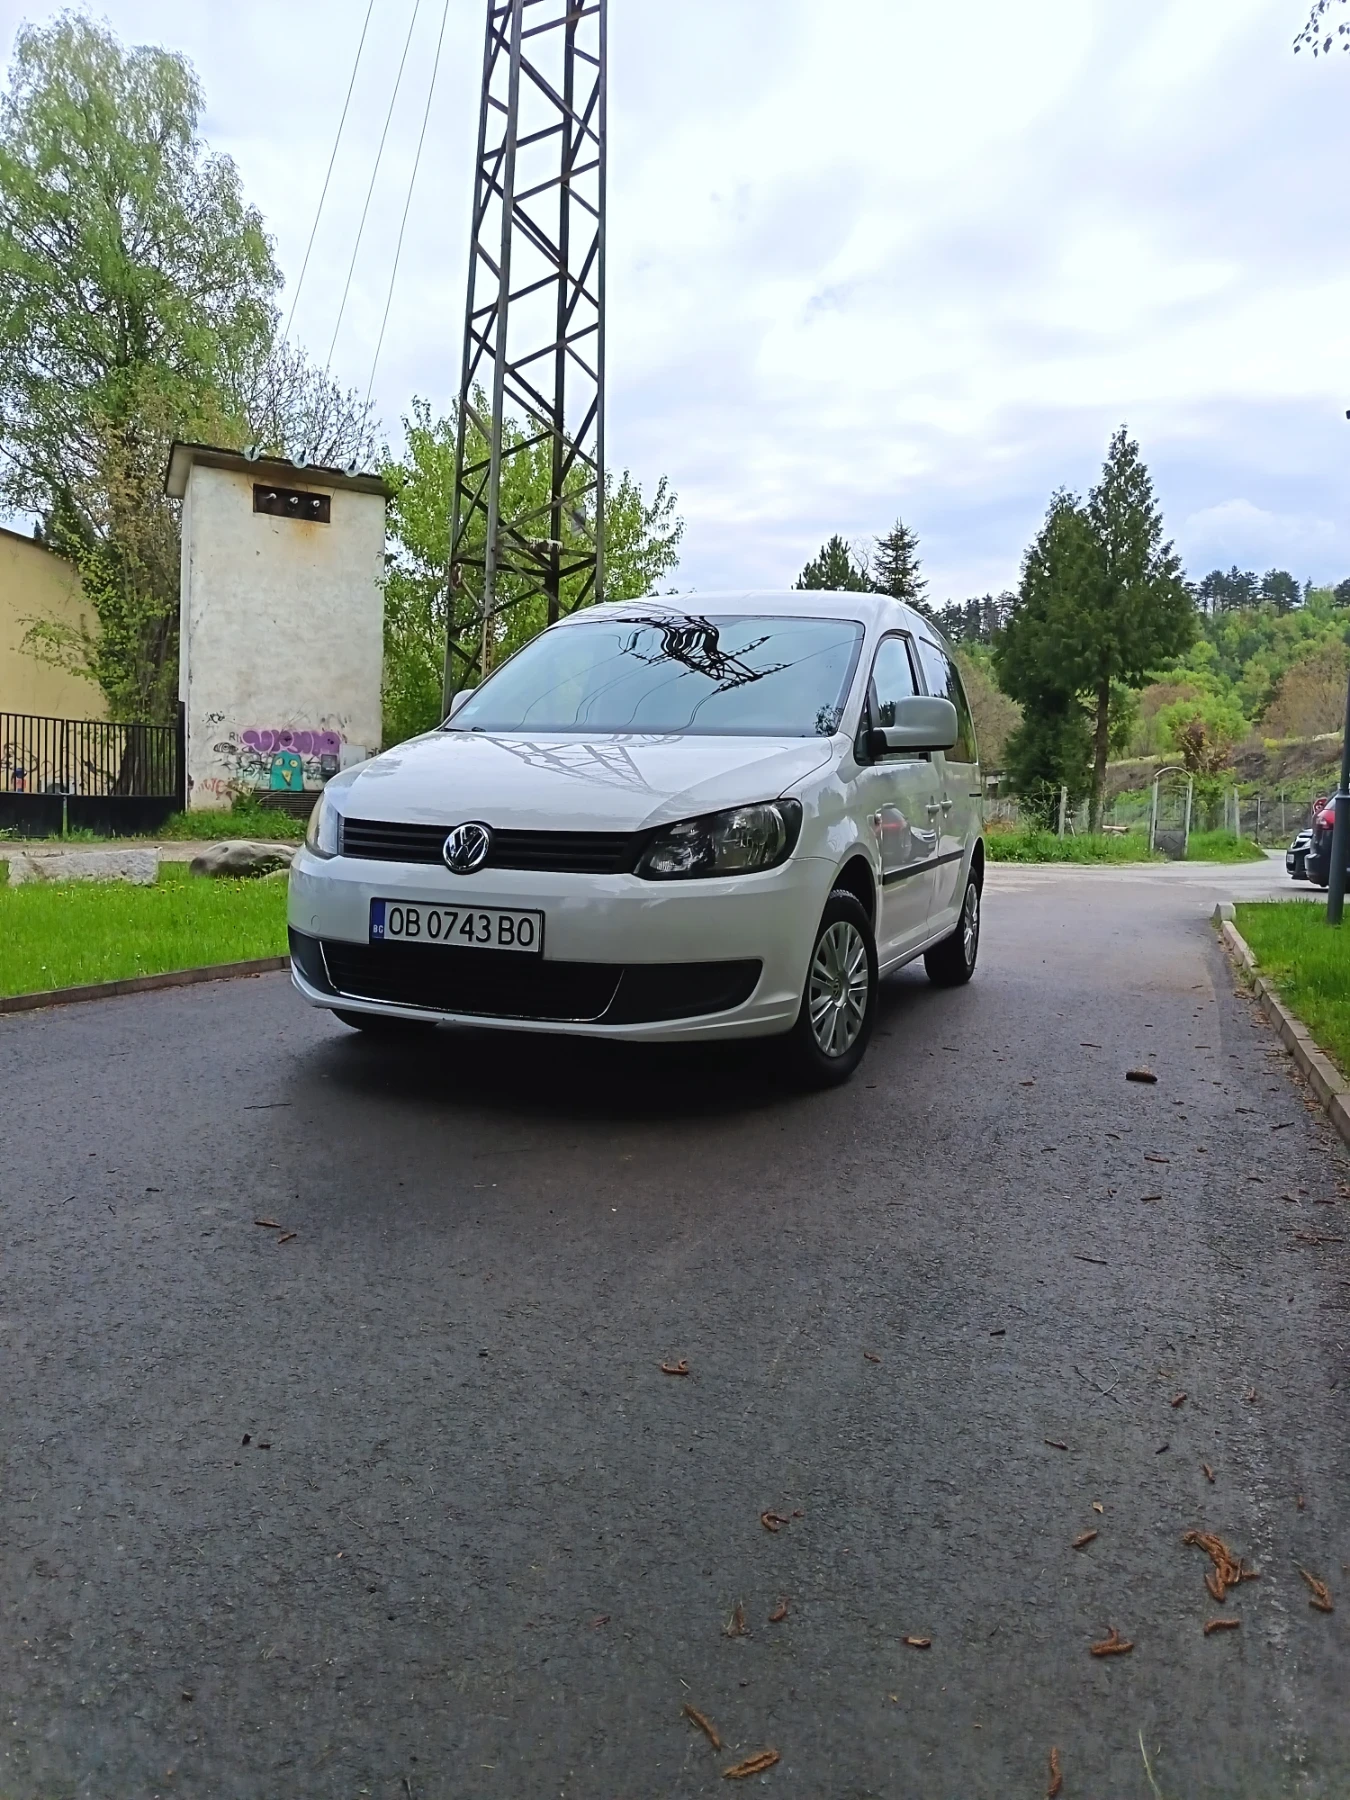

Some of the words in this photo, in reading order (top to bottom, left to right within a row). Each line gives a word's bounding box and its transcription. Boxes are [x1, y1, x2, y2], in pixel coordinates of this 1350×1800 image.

[389, 907, 421, 937] OB
[427, 910, 492, 943] 0743
[497, 915, 535, 947] BO
